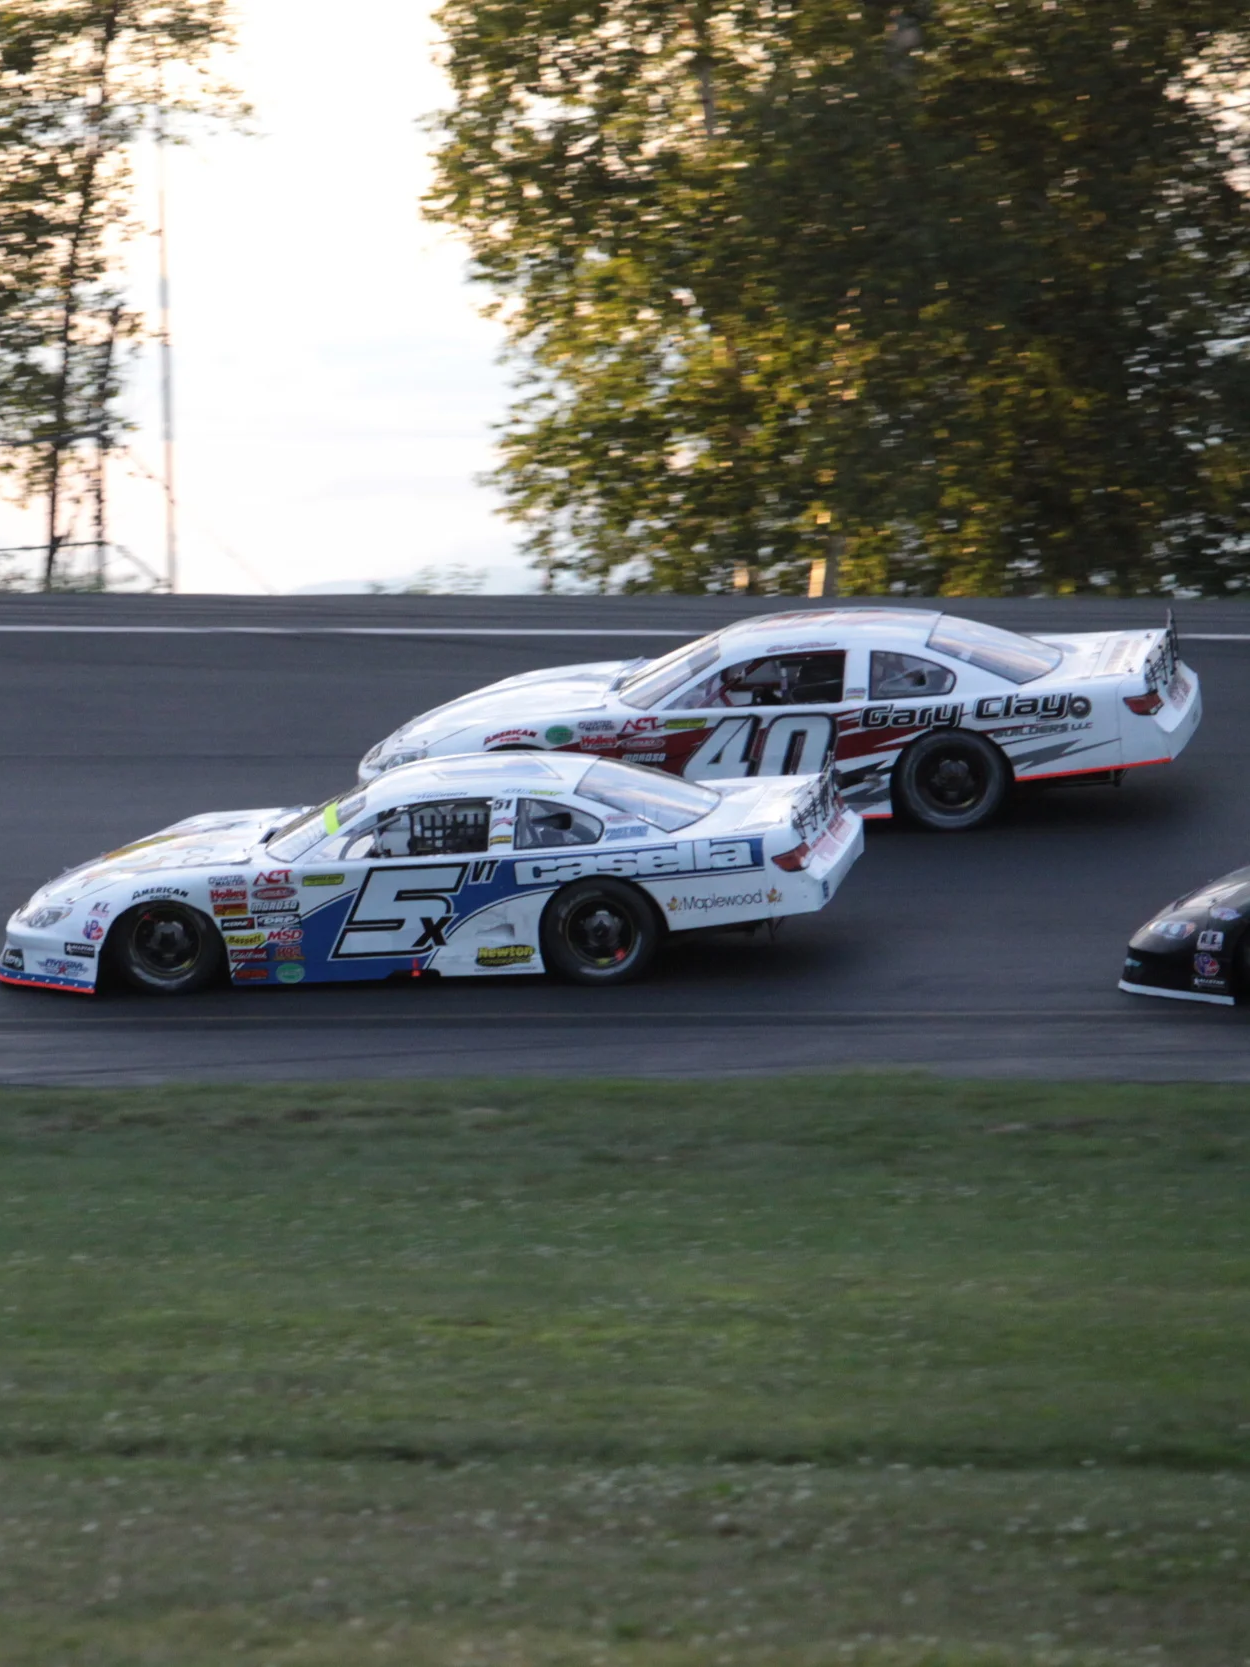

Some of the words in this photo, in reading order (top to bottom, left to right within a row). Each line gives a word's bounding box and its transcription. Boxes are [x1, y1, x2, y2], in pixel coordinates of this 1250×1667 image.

[860, 703, 964, 730] Gary
[972, 693, 1073, 722] Clay
[622, 717, 659, 733] ACT
[991, 722, 1069, 739] BUILDERS
[1070, 721, 1093, 731] LLC
[483, 728, 537, 746] AMERICAN
[682, 712, 840, 779] 40
[514, 837, 755, 885] casella
[252, 869, 294, 886] ACT
[467, 859, 499, 885] VT
[132, 886, 190, 900] AMERICAN
[210, 888, 247, 901] Holley
[252, 902, 297, 911] MOROSO
[683, 891, 762, 913] Maplewood
[228, 934, 262, 944] Bassett
[267, 929, 303, 941] MSD
[478, 946, 535, 958] Newton
